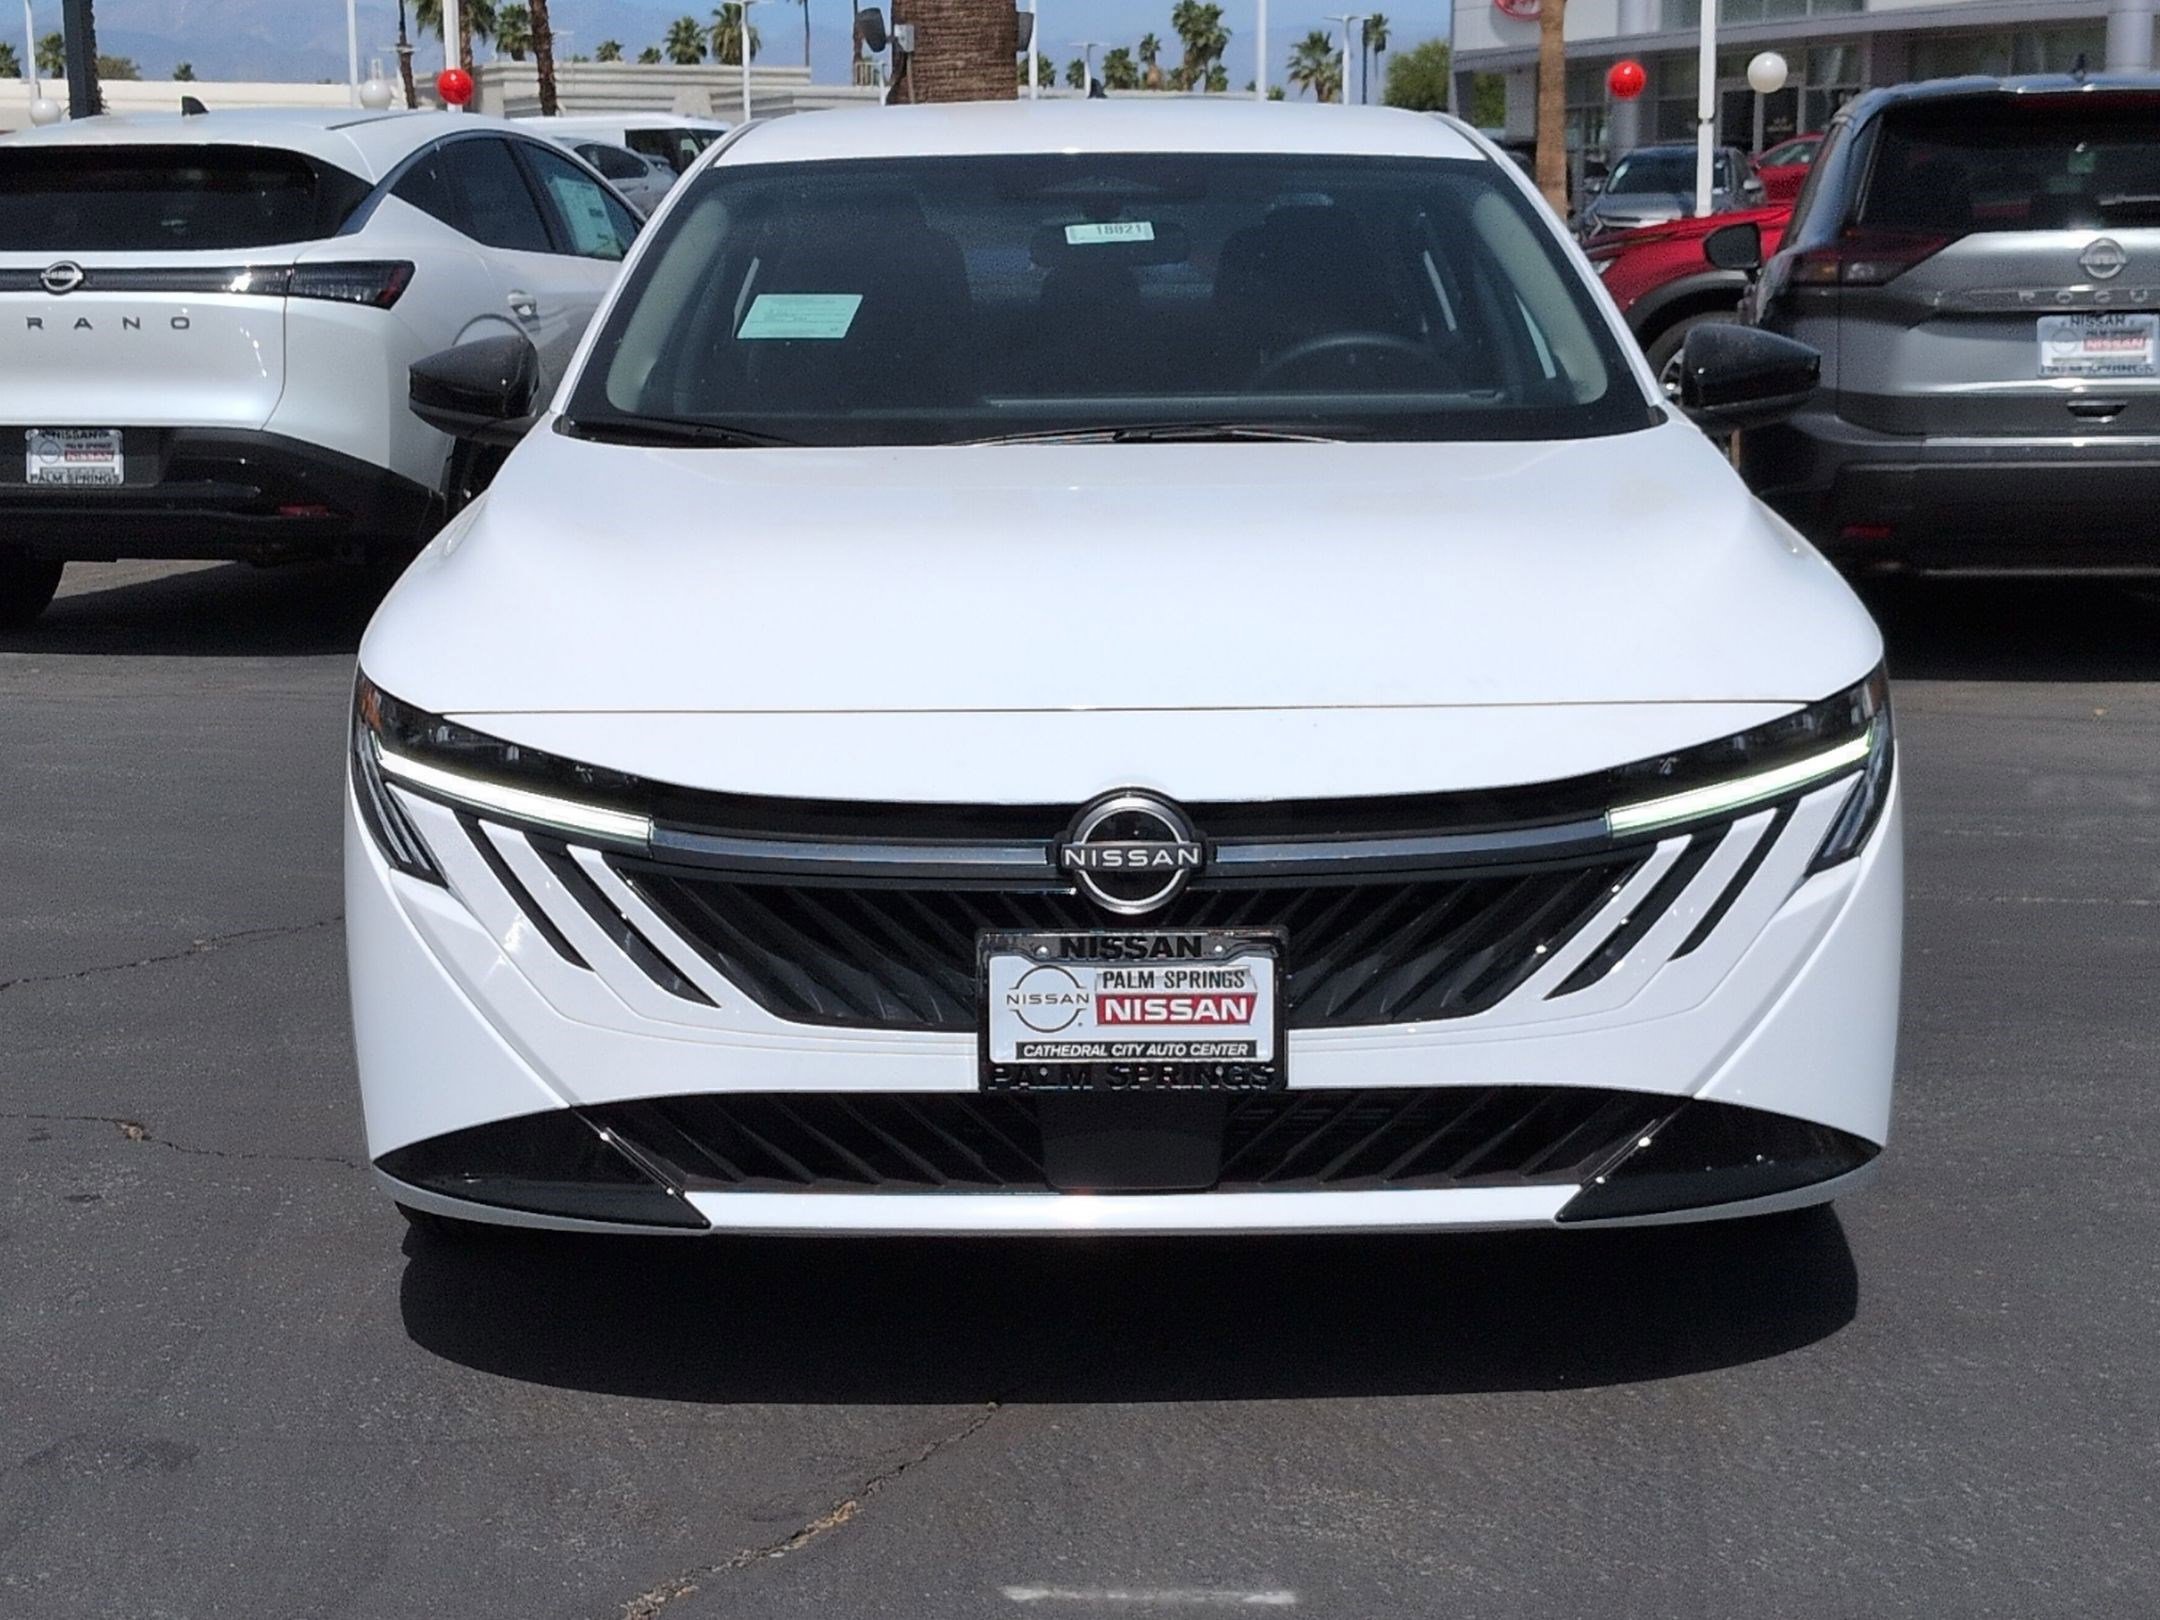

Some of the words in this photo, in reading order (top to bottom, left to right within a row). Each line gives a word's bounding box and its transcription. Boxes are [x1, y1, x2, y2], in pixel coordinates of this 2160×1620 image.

[1064, 847, 1199, 867] NISSAN
[1061, 936, 1202, 959] NISSAN
[1103, 971, 1155, 989] PALM
[1164, 970, 1246, 989] SPRINGS
[1006, 993, 1090, 1006] NISSAN
[1105, 998, 1248, 1021] NISSAN
[1023, 1044, 1109, 1058] CATHEDRAL
[1111, 1044, 1145, 1057] CITY
[1146, 1044, 1186, 1057] AUTO
[1189, 1043, 1249, 1057] CENTER
